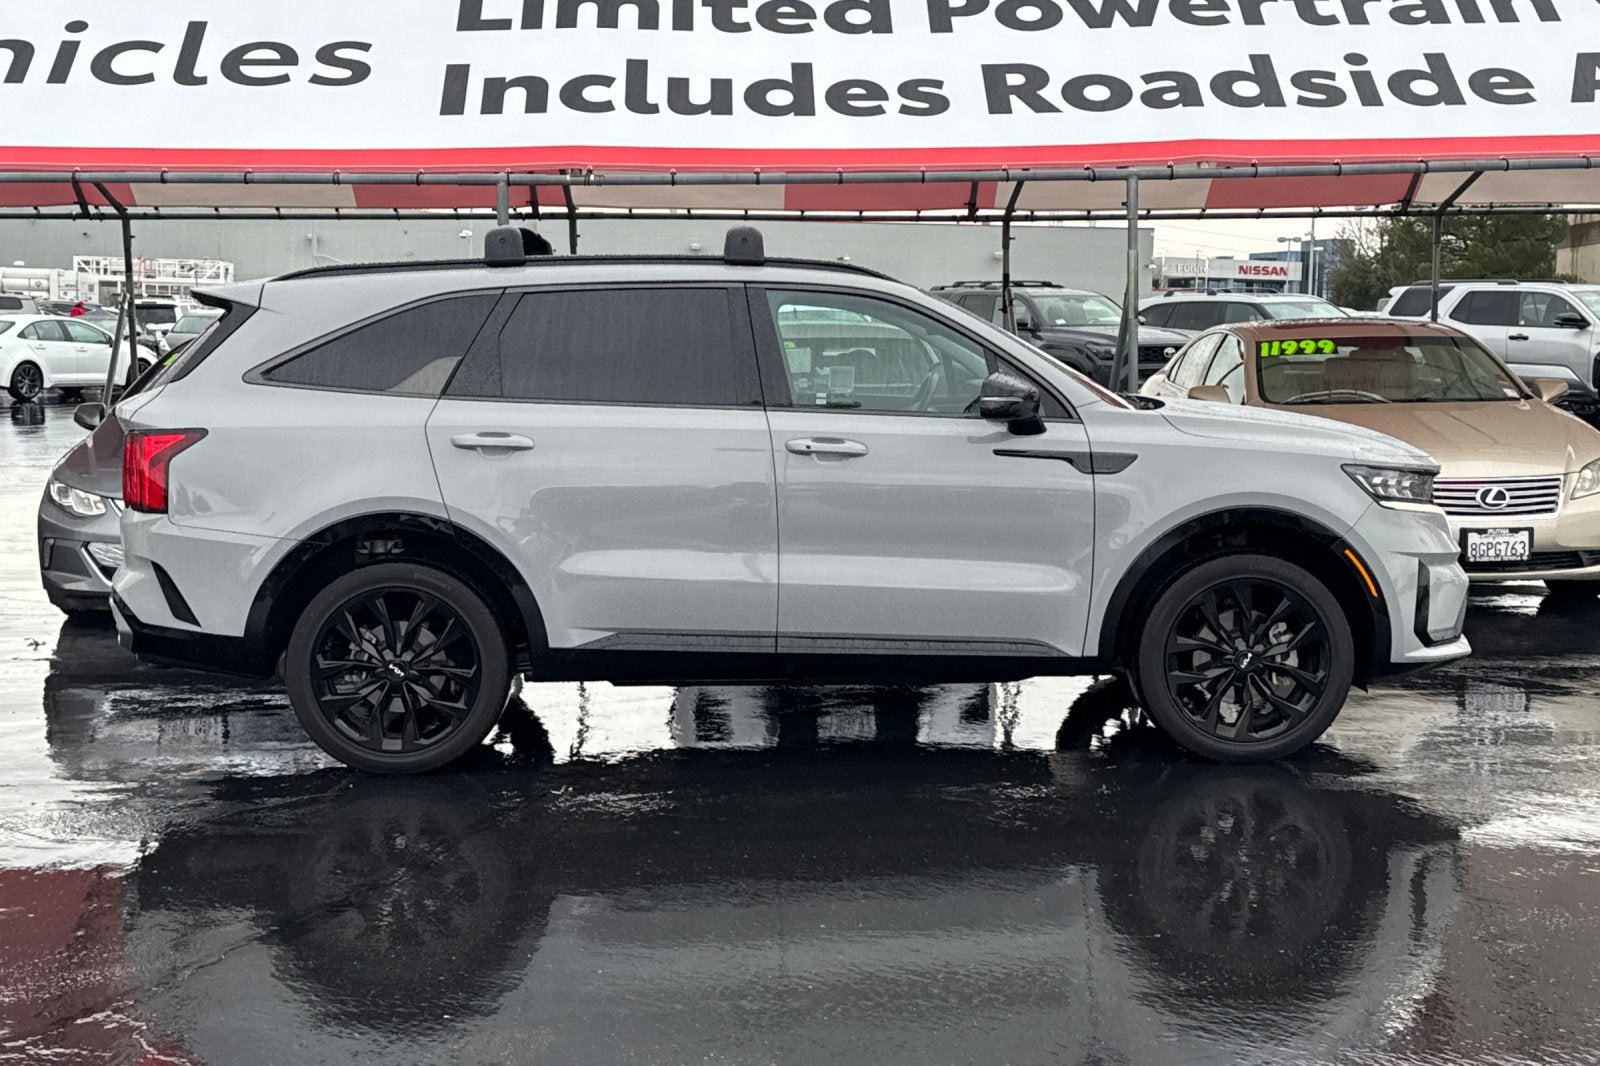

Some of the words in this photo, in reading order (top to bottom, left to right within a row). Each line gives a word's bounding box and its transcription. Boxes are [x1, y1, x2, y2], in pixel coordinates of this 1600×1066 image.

[456, 0, 893, 34] Limited
[440, 58, 950, 117] Includes
[981, 53, 1537, 115] Roadside
[1238, 265, 1288, 276] NISSAN
[1260, 339, 1336, 357] 11999
[1470, 541, 1526, 557] 8GPG763
